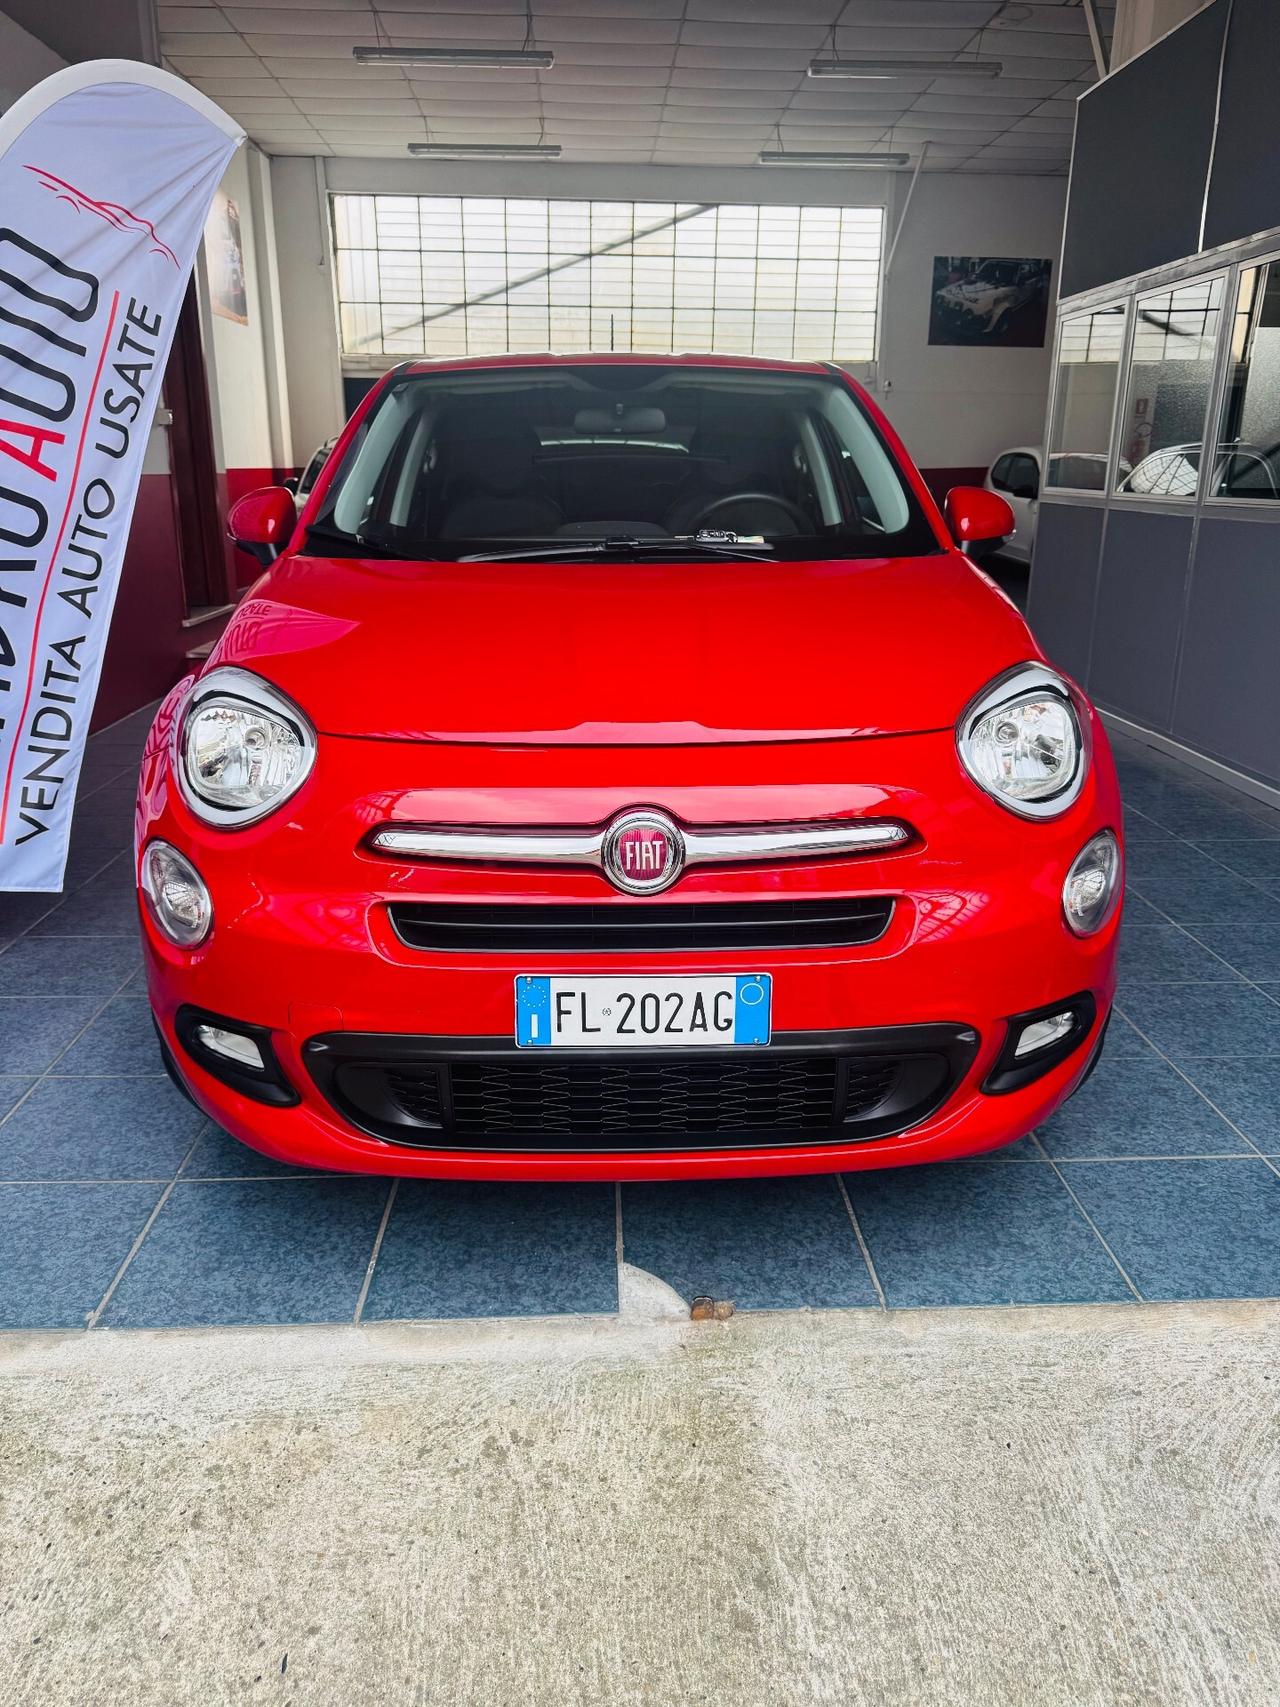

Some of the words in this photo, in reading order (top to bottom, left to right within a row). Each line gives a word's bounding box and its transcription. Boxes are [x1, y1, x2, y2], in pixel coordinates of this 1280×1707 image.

[15, 635, 86, 846] VENDITA
[57, 478, 116, 620] AUTO
[95, 297, 162, 459] USATE
[625, 840, 663, 870] FIAT
[556, 991, 601, 1033] FL
[616, 991, 733, 1034] 202AG
